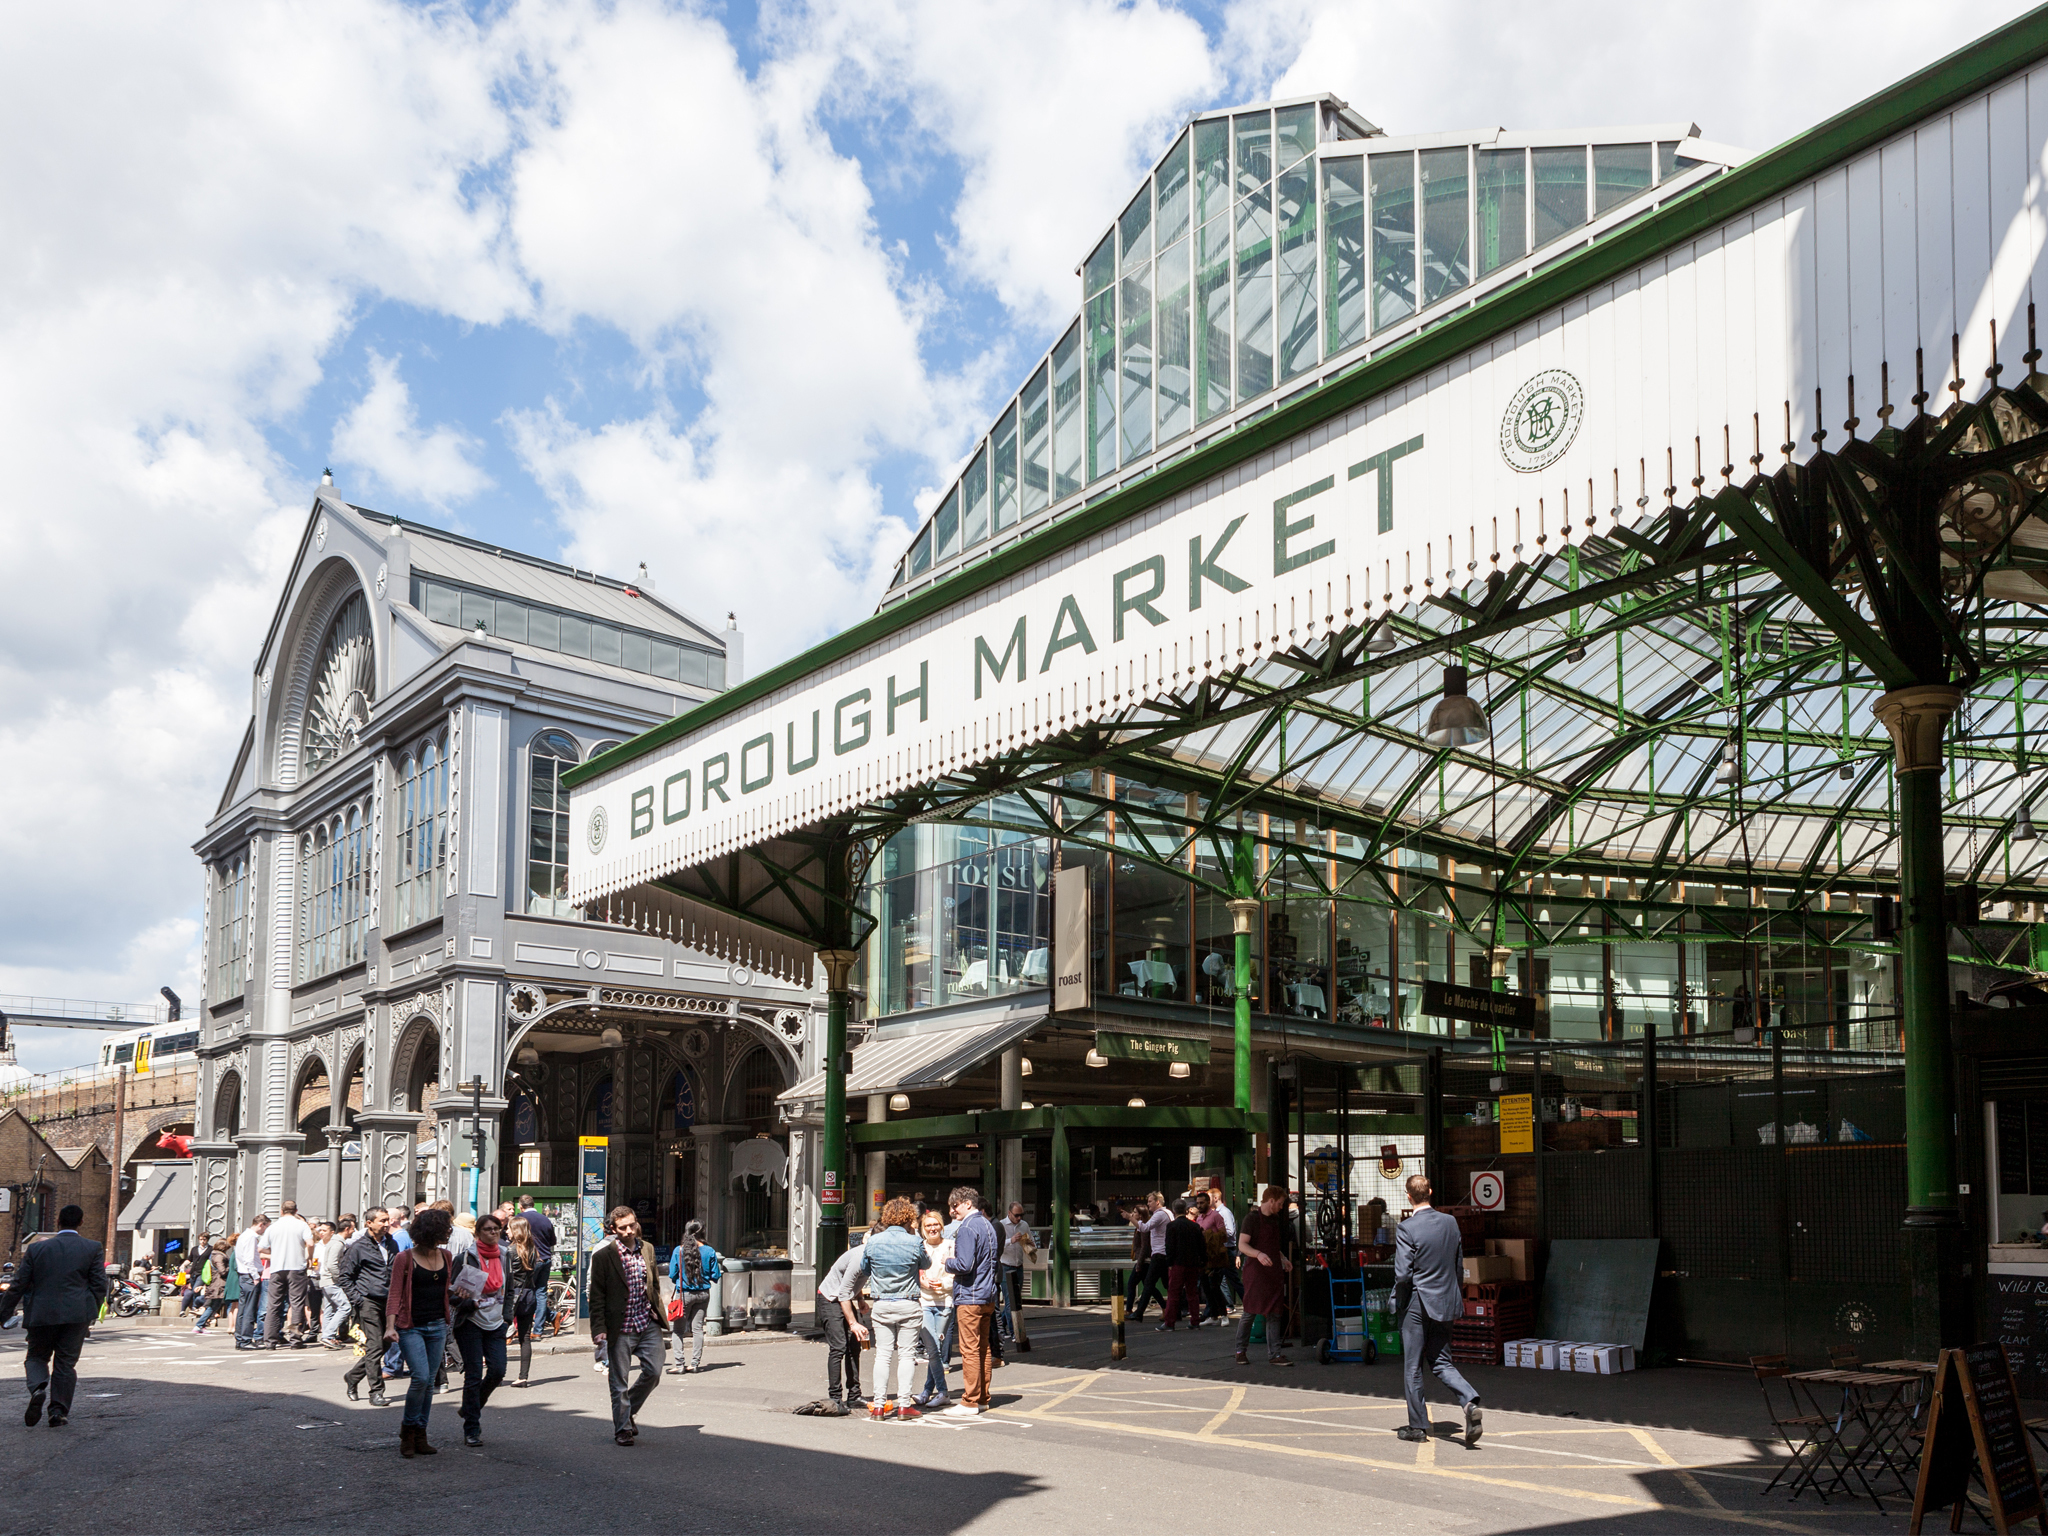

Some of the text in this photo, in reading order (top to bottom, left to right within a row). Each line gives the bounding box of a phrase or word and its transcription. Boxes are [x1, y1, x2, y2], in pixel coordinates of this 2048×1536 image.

[1504, 377, 1545, 449] BOROUGH
[1550, 375, 1579, 422] MARKET
[1528, 450, 1554, 464] 1756
[630, 434, 1425, 840] BOROUGH MARKET
[1058, 971, 1082, 987] roast
[1443, 992, 1453, 1005] Le
[1454, 993, 1479, 1010] Marché
[1480, 998, 1488, 1012] du
[1130, 1039, 1179, 1055] The Ginger Pig
[1483, 1183, 1493, 1199] 5
[1998, 1280, 2031, 1293] Wild
[1998, 1335, 2031, 1346] CLAM
